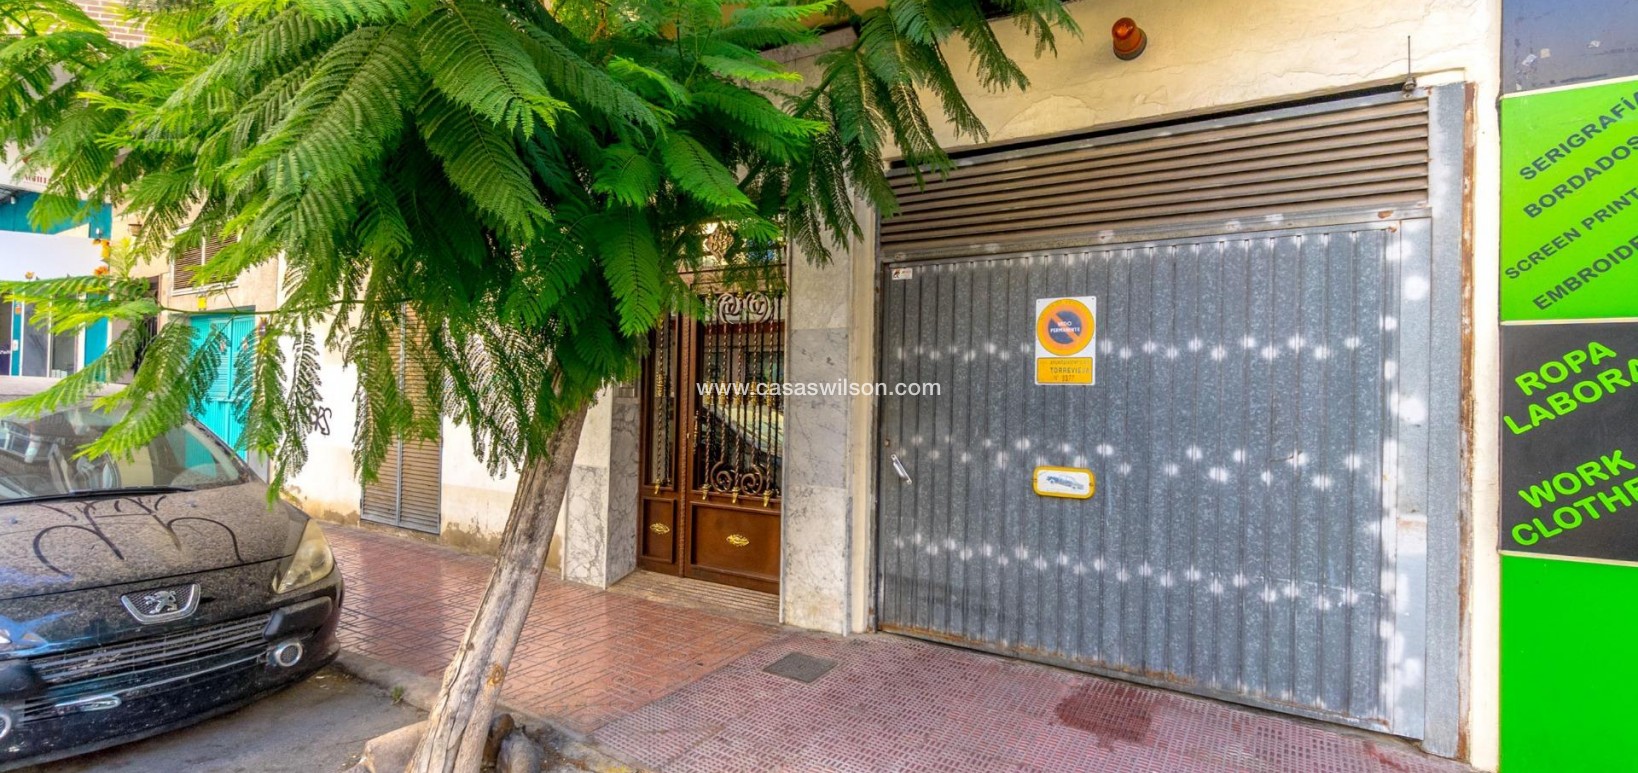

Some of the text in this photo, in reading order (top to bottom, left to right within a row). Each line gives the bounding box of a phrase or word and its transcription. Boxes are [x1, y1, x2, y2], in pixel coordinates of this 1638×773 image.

[1519, 91, 1638, 180] SERIGRAFÍ
[1523, 136, 1638, 218] BORDADOS
[1505, 227, 1582, 279] SCREEN
[1514, 341, 1617, 396] ROPA
[1518, 449, 1636, 508] WORK
